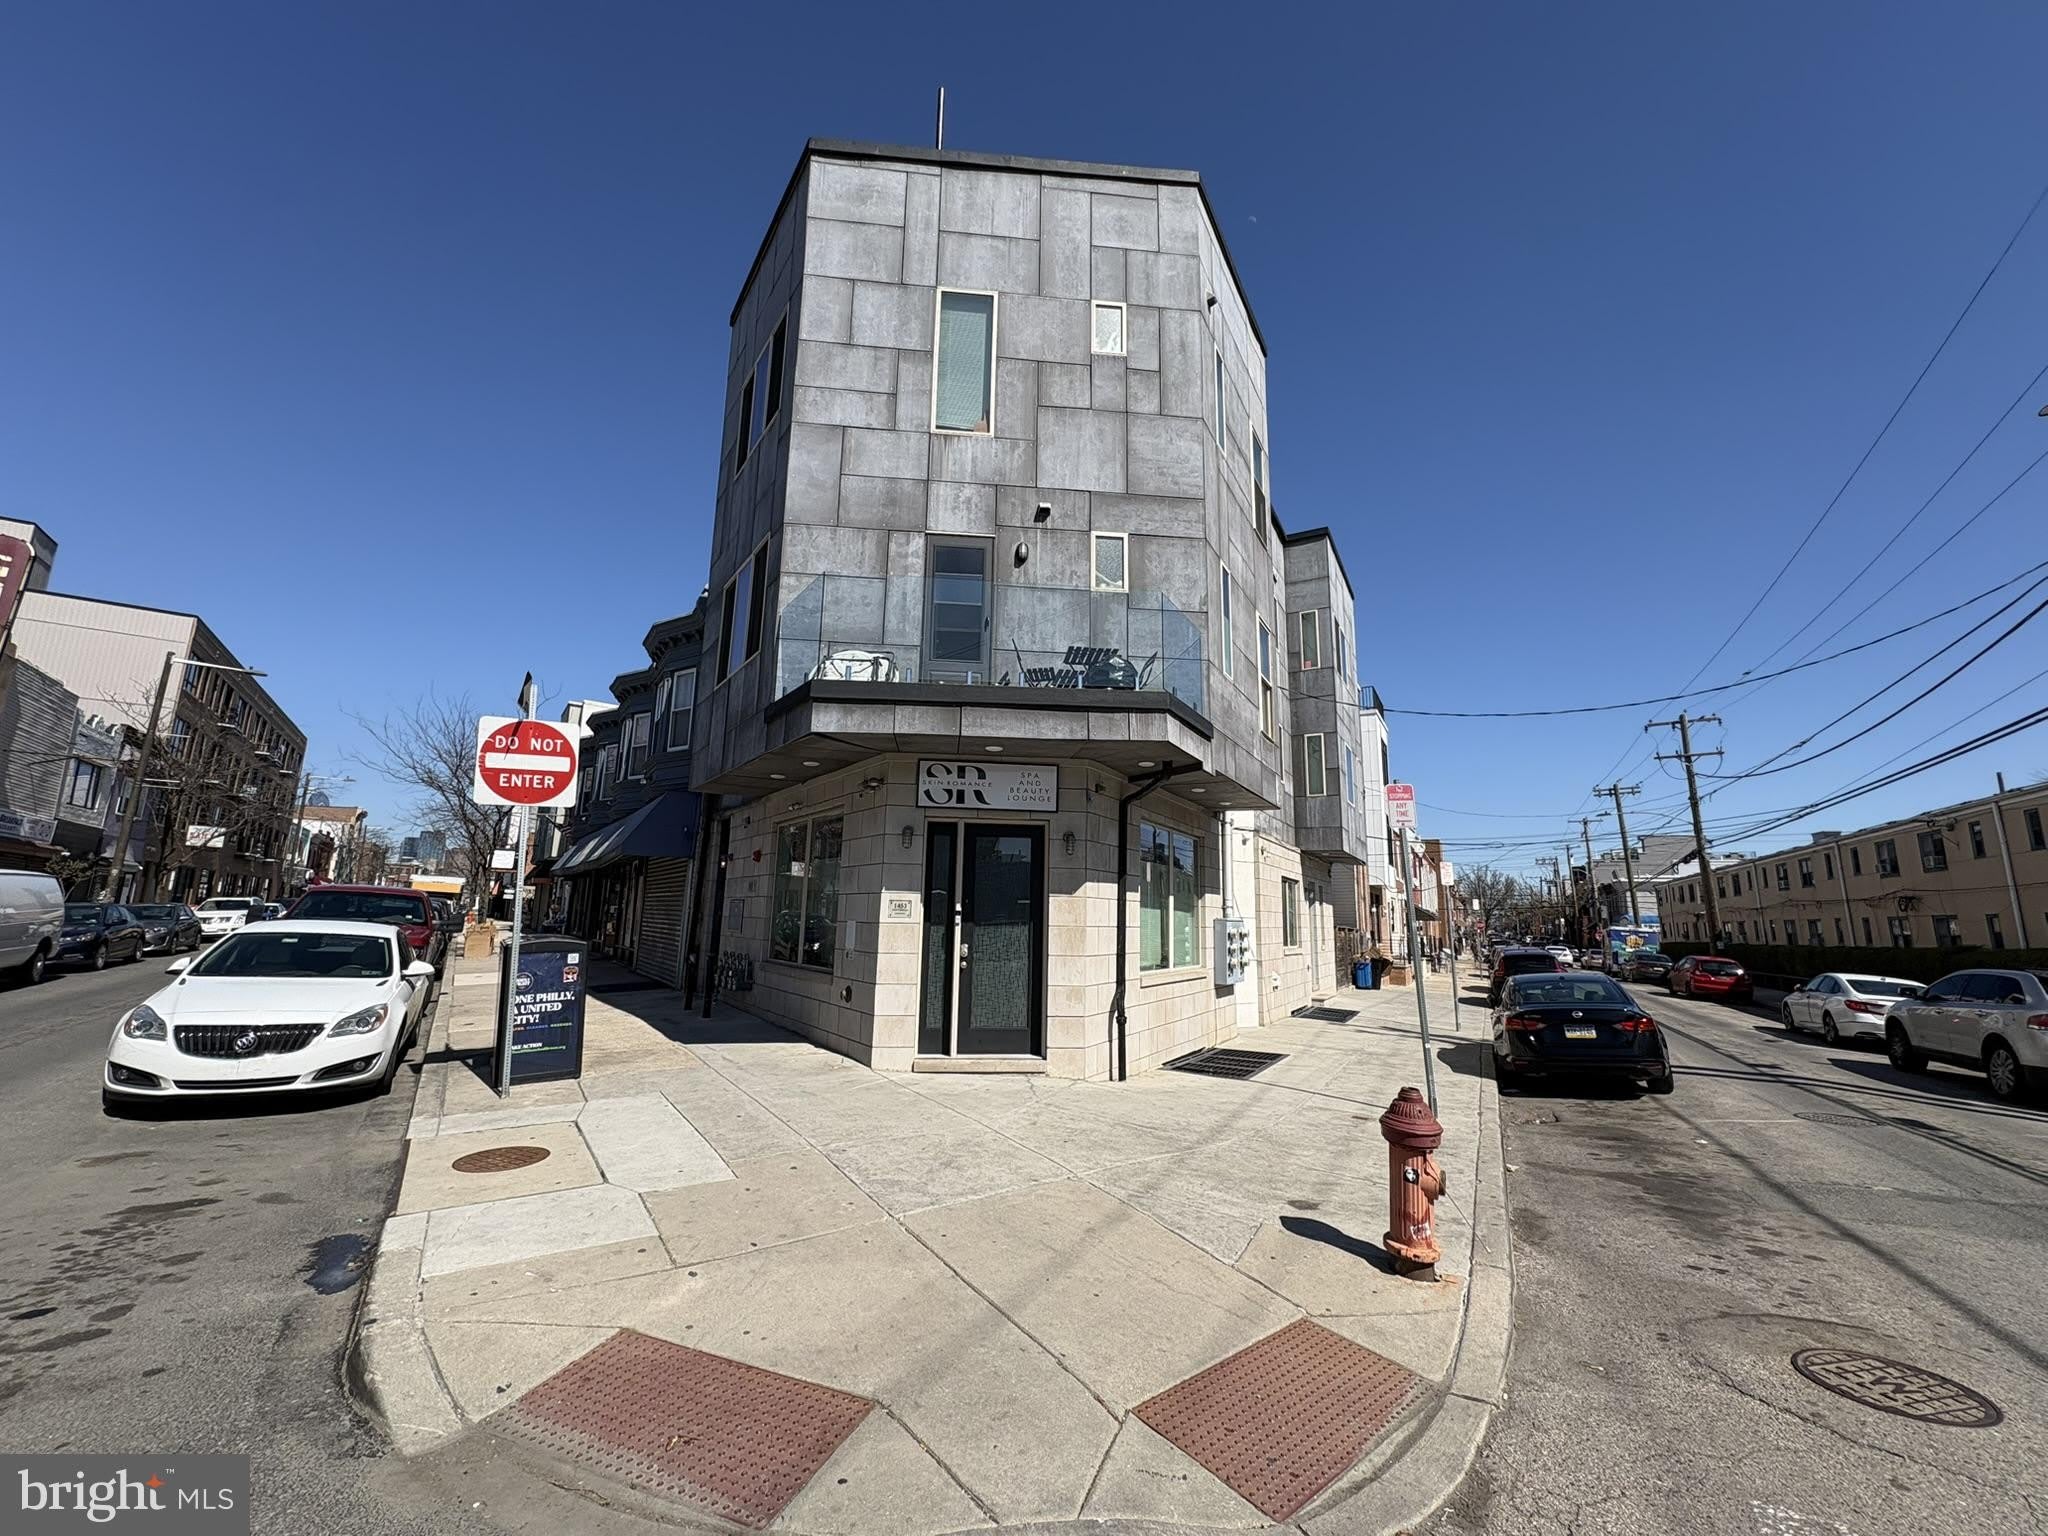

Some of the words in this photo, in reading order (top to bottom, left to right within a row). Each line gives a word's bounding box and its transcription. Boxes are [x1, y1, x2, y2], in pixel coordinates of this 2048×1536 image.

[495, 735, 519, 749] DO
[530, 738, 564, 752] NOT
[499, 773, 555, 789] ENTER
[946, 780, 993, 788] ROMANCE
[1009, 787, 1051, 795] BEAUTY
[1008, 795, 1052, 803] LOUNGE
[536, 991, 575, 1002] PHILLY,
[520, 1002, 562, 1013] UNITED
